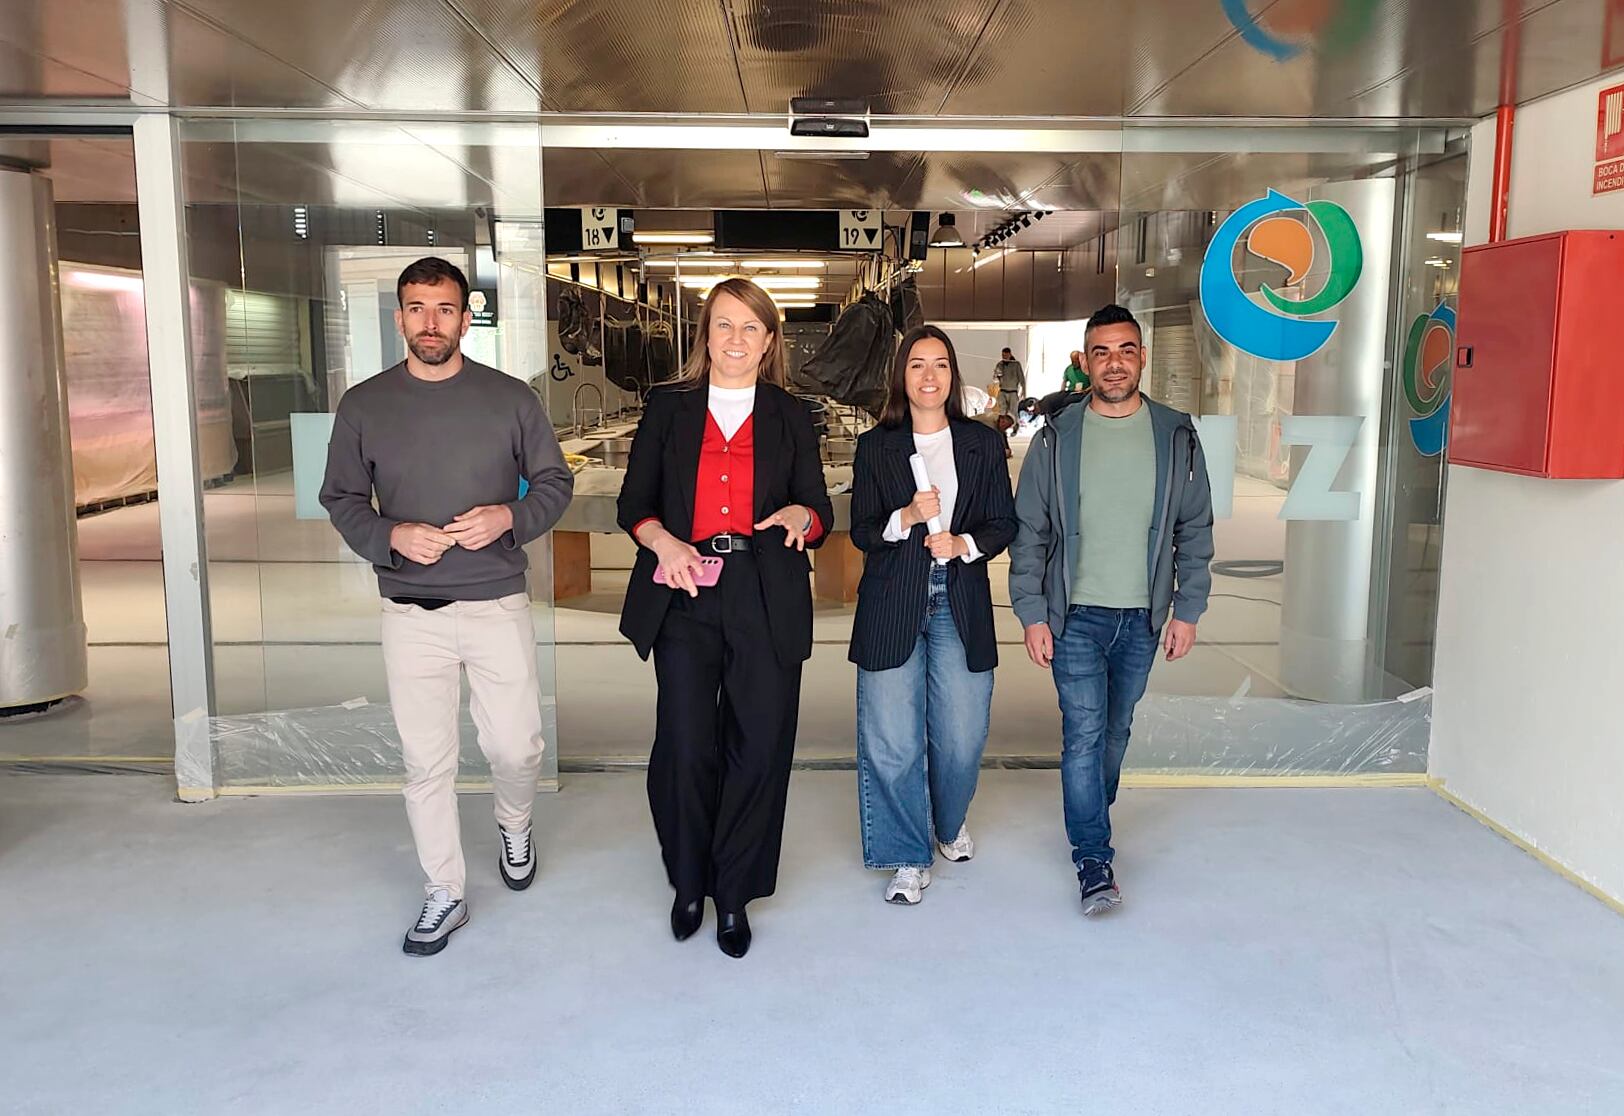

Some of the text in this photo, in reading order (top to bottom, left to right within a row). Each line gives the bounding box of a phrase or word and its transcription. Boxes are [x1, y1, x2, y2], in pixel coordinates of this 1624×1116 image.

[1598, 164, 1618, 177] BOCA
[585, 228, 600, 246] 18
[843, 227, 860, 245] 19
